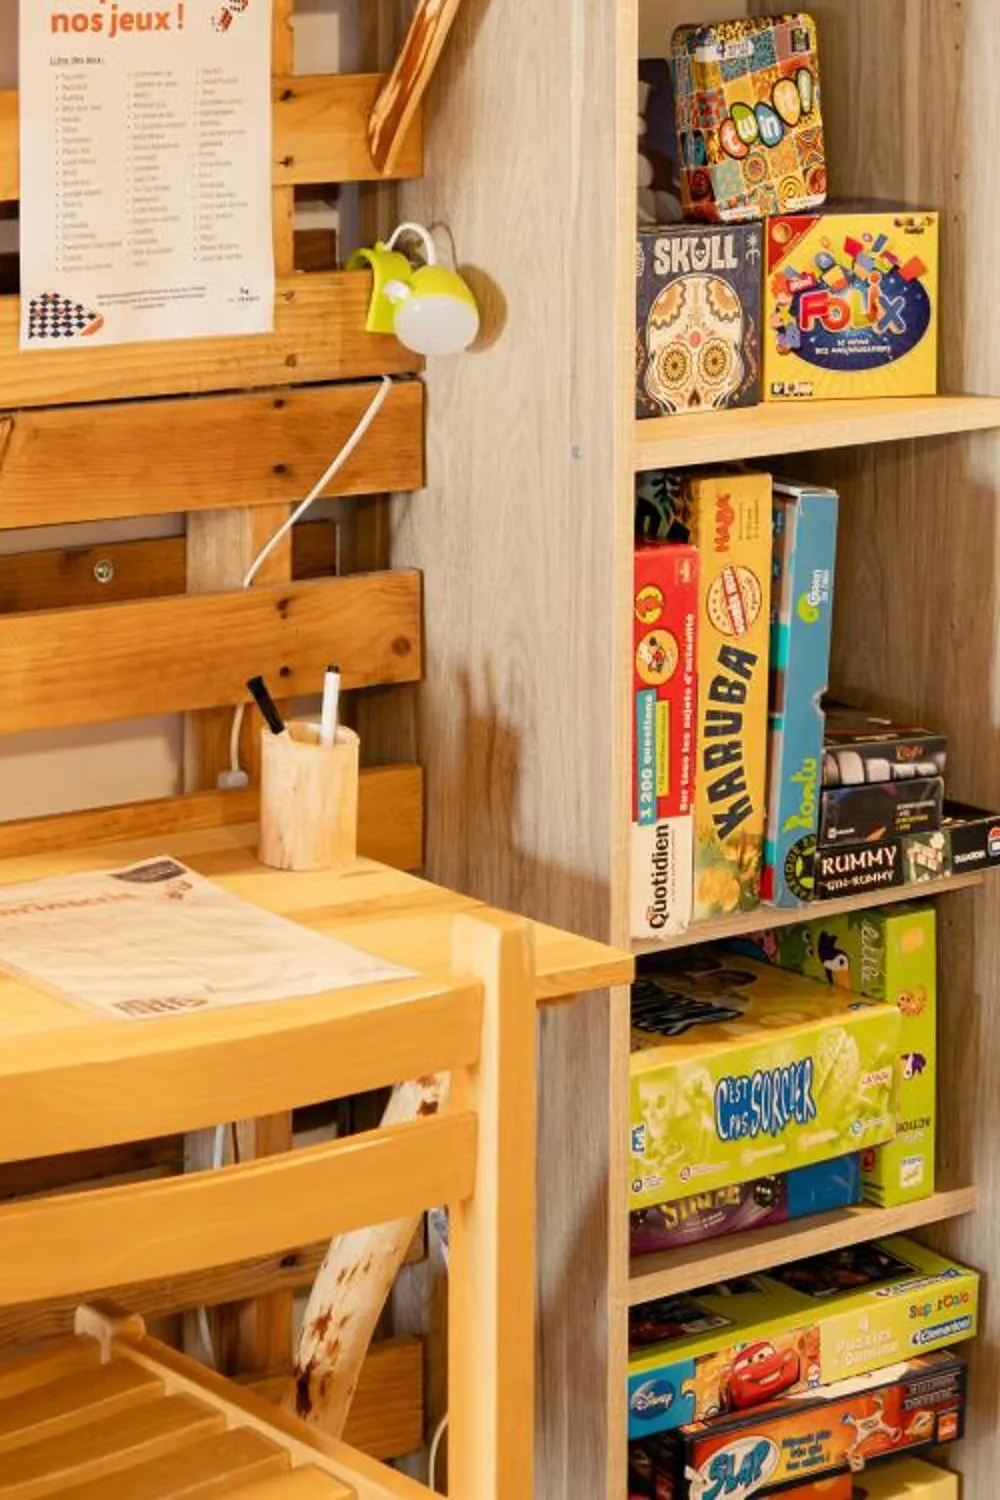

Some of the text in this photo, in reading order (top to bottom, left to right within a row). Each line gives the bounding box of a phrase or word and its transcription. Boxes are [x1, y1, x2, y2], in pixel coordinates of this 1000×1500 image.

[51, 3, 184, 38] nos jeux !
[654, 233, 738, 274] SKULL
[643, 694, 654, 759] questions
[704, 644, 758, 841] KARUBA
[640, 768, 653, 801] 200
[650, 824, 669, 929] Quotidien
[822, 845, 897, 875] RUMMY
[750, 1058, 816, 1138] SORCIER
[637, 1390, 674, 1411] Disney
